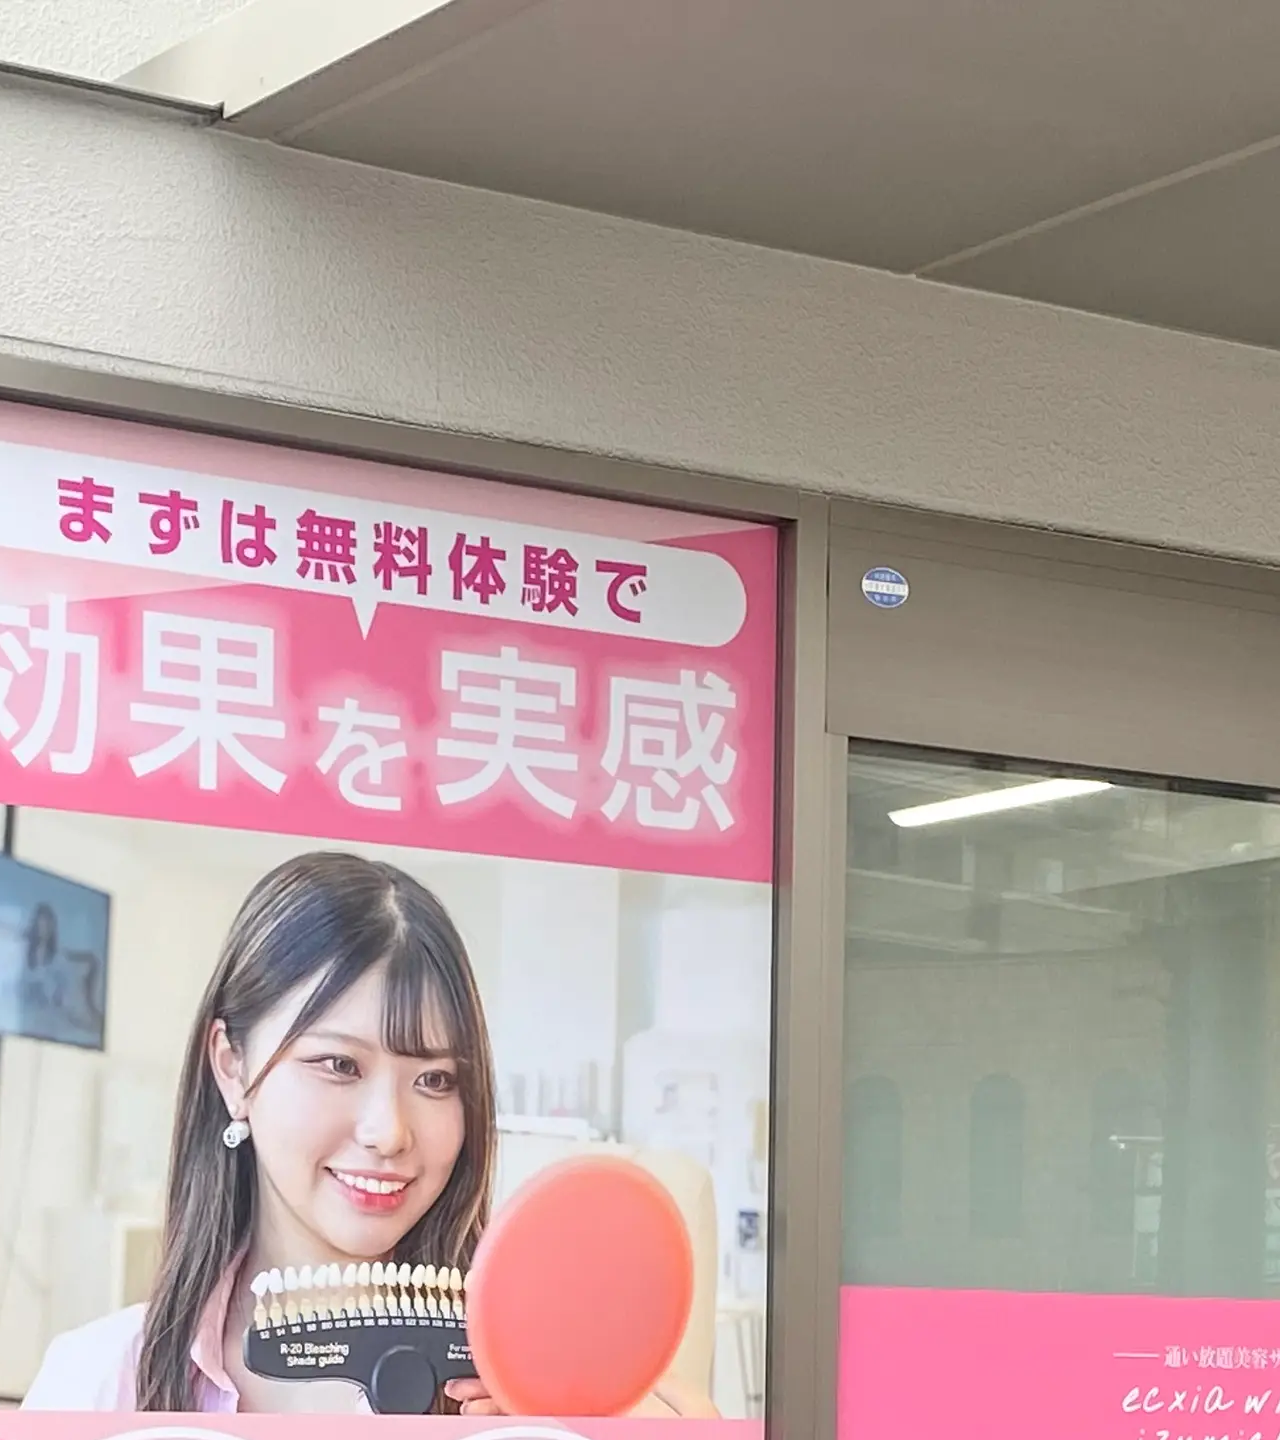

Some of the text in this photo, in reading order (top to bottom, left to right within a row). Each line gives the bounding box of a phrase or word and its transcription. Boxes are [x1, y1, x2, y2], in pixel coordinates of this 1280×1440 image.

[56, 476, 647, 625] まずは無料体験で
[1122, 1384, 1234, 1414] ecxia
